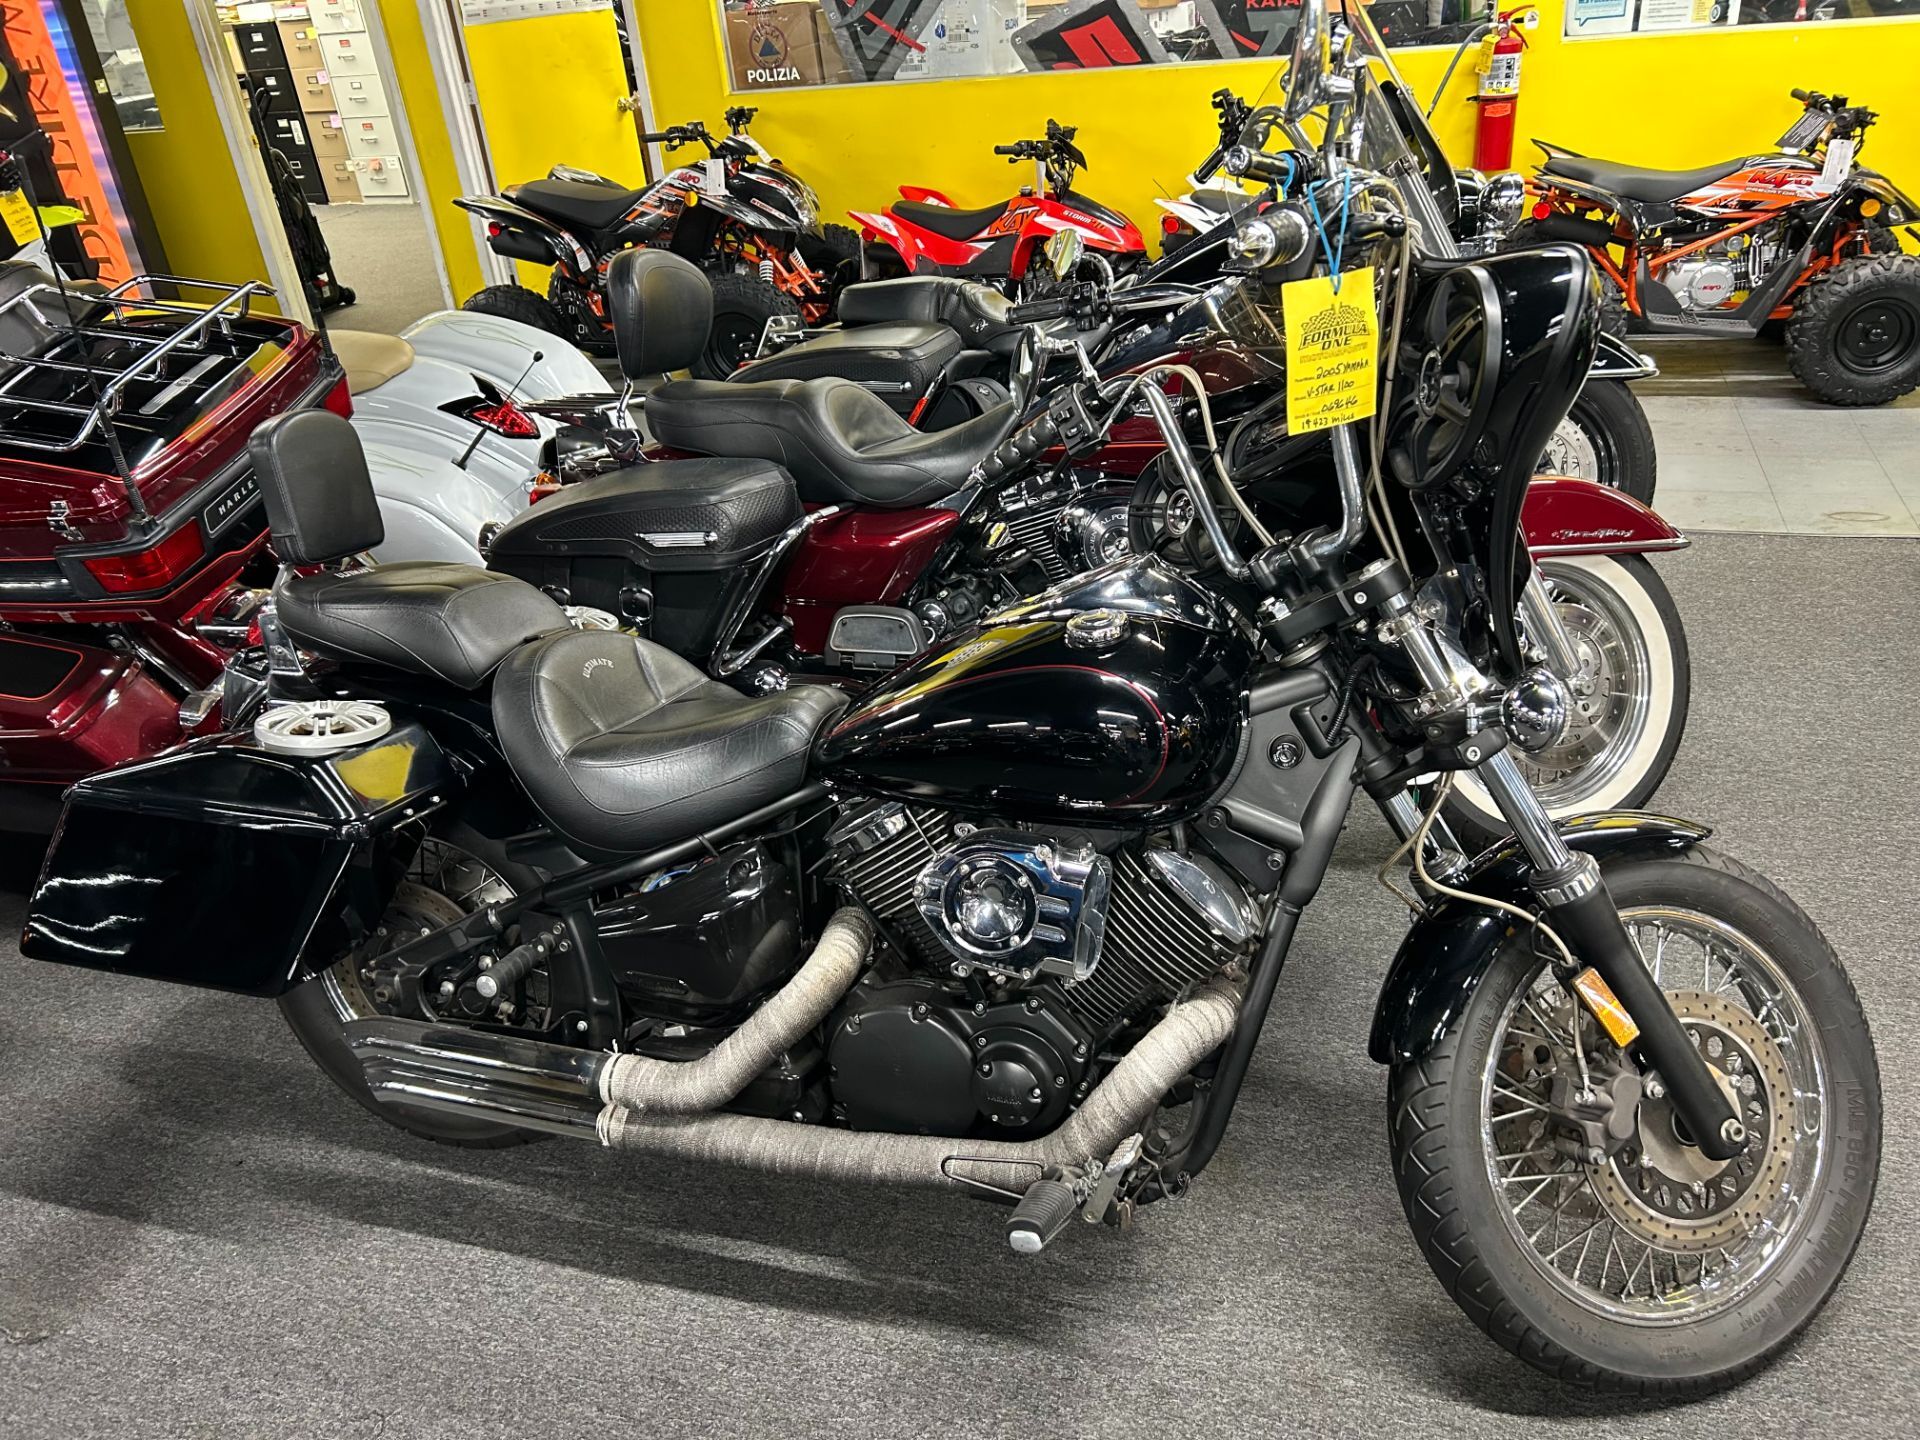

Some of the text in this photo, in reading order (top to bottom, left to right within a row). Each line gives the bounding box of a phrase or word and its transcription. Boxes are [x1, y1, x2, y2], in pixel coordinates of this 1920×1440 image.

[747, 67, 800, 83] POLIZIA
[1747, 171, 1815, 188] KAYO
[1063, 210, 1091, 224] STORM
[1302, 323, 1367, 347] FORMULA
[1322, 336, 1352, 350] ONE
[1316, 362, 1343, 379] 2005
[218, 475, 257, 516] HARLE
[582, 657, 614, 678] ULTIMATE
